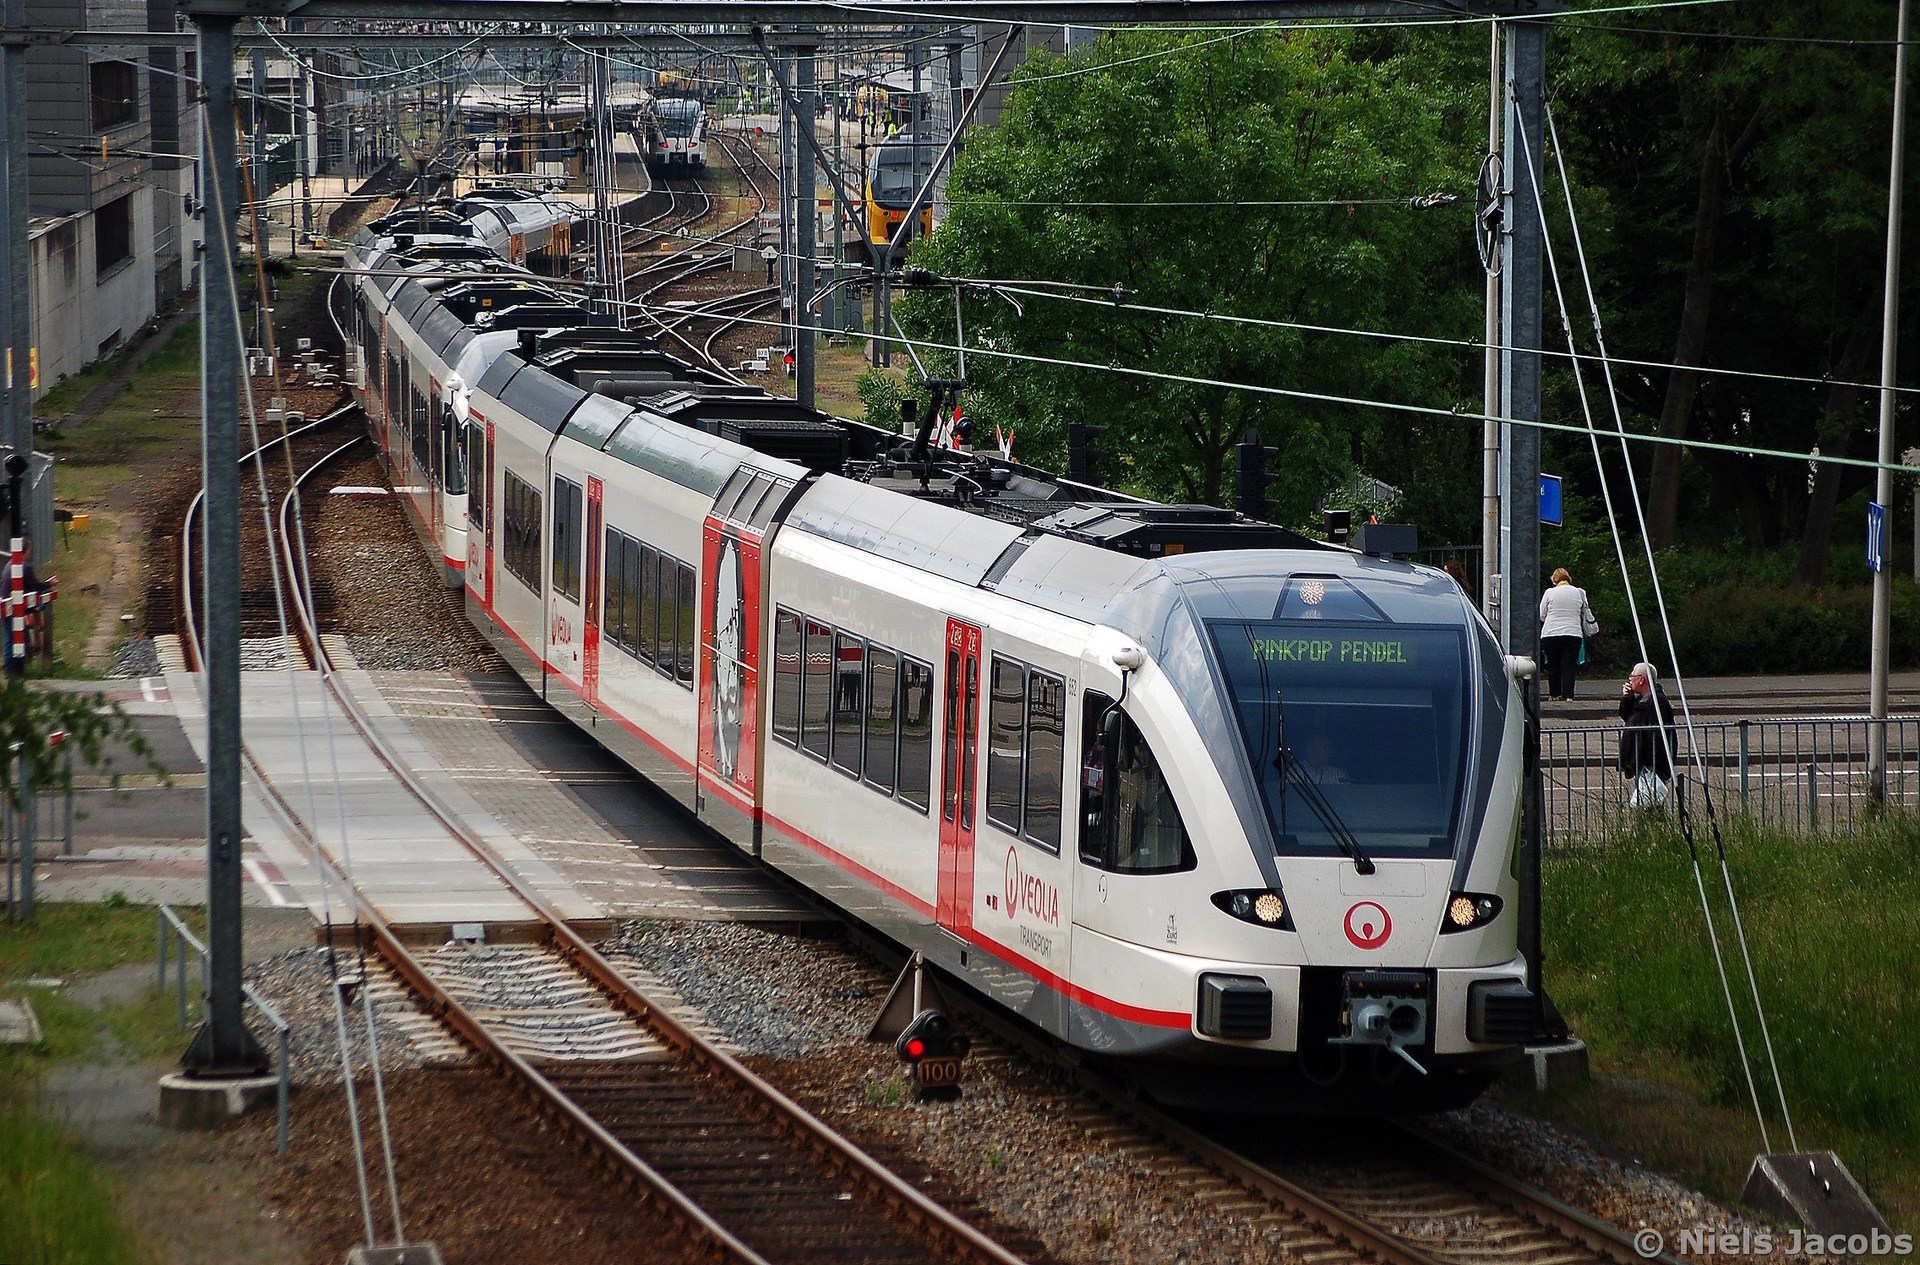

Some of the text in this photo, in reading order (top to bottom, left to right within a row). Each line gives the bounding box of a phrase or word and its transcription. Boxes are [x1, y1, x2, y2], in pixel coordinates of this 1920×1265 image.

[1253, 638, 1407, 663] PINKPOP PENDEL
[1020, 871, 1059, 928] VEOLIA
[1019, 925, 1052, 959] TRANSPORT
